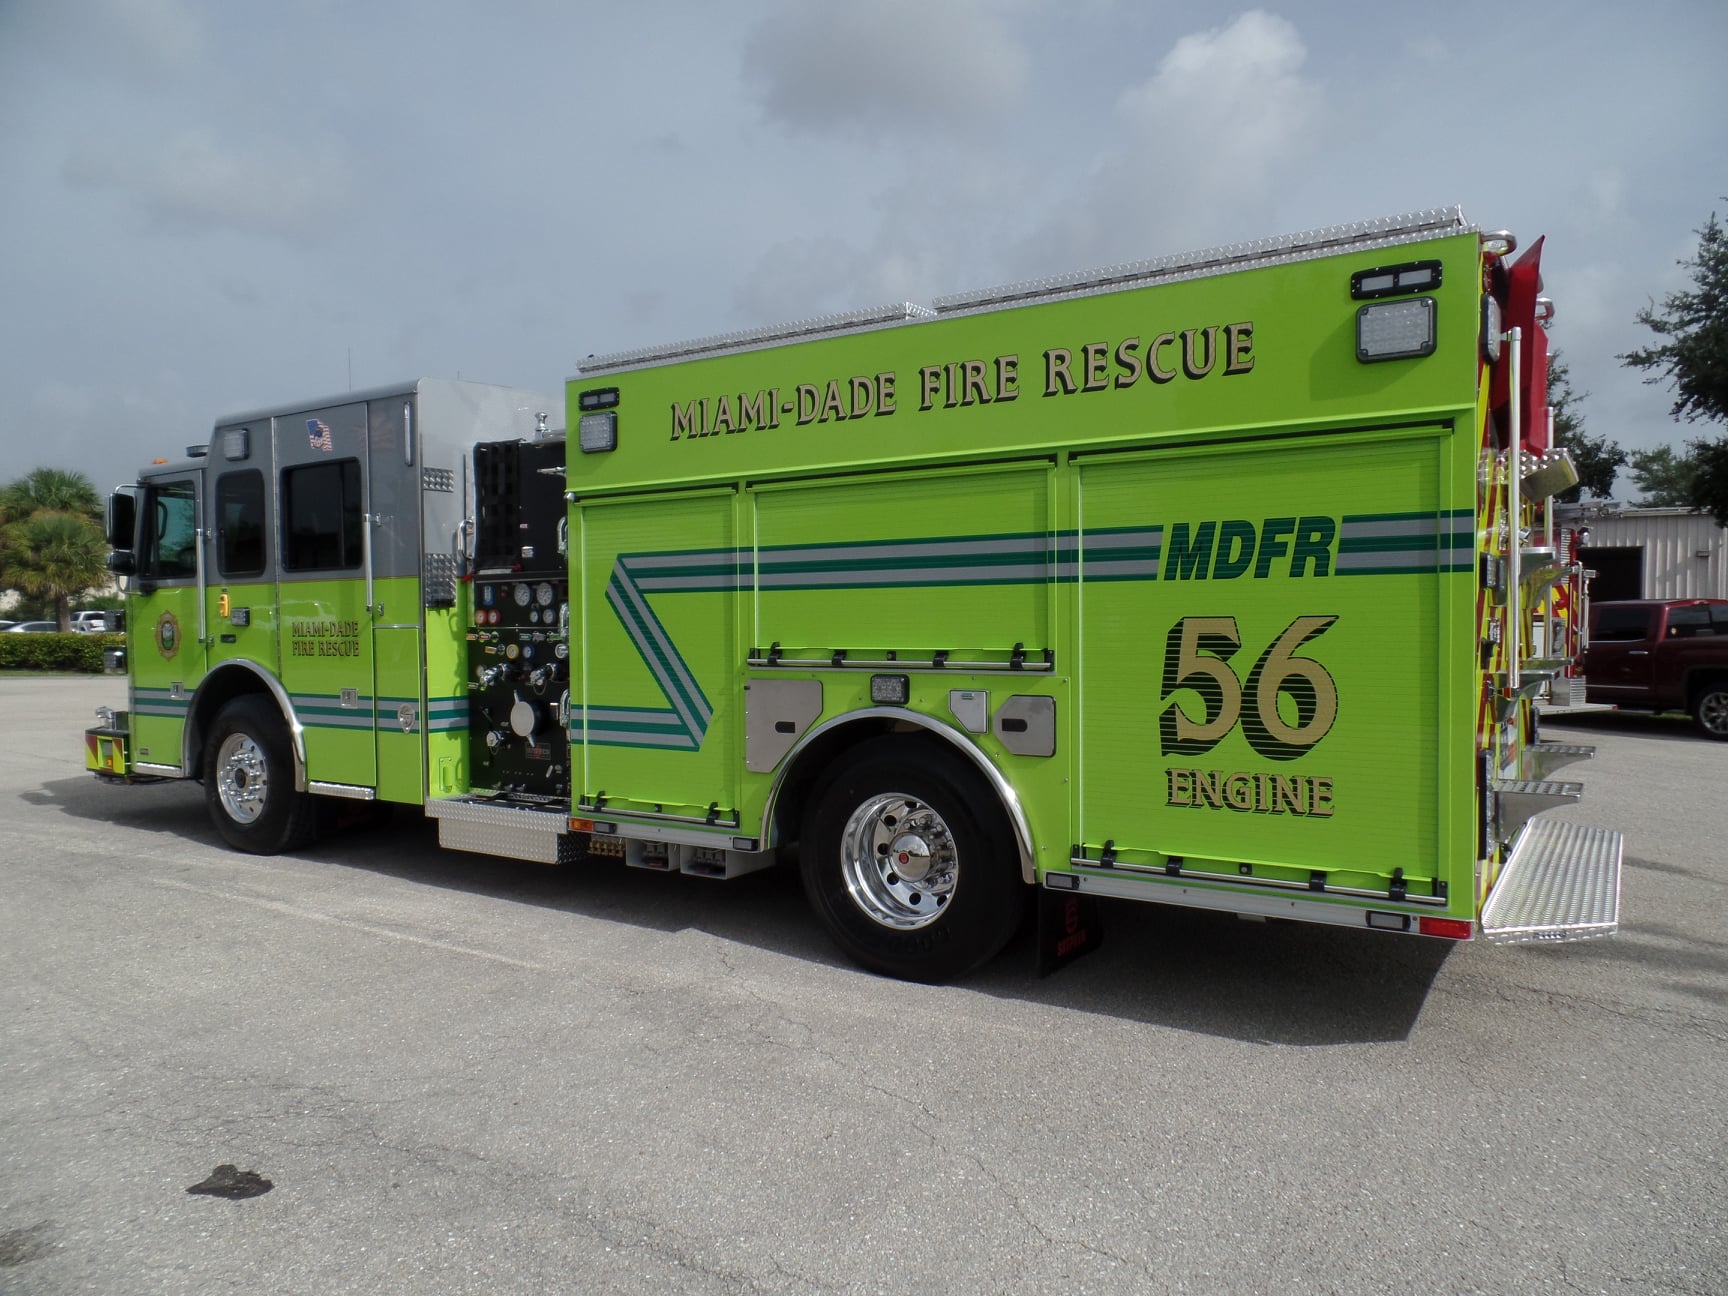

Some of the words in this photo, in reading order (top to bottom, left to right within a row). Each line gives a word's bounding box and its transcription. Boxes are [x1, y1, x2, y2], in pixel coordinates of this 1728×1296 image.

[670, 371, 896, 441] MIAMI-DADE
[918, 354, 1020, 411] FIRE
[1042, 321, 1255, 398] RESCUE
[1164, 515, 1336, 581] MDFR
[292, 621, 359, 637] MIAMI-DADE
[292, 640, 315, 656] FIRE
[318, 640, 359, 656] RESCUE
[1159, 615, 1340, 761] 56
[1165, 767, 1335, 819] ENGINE
